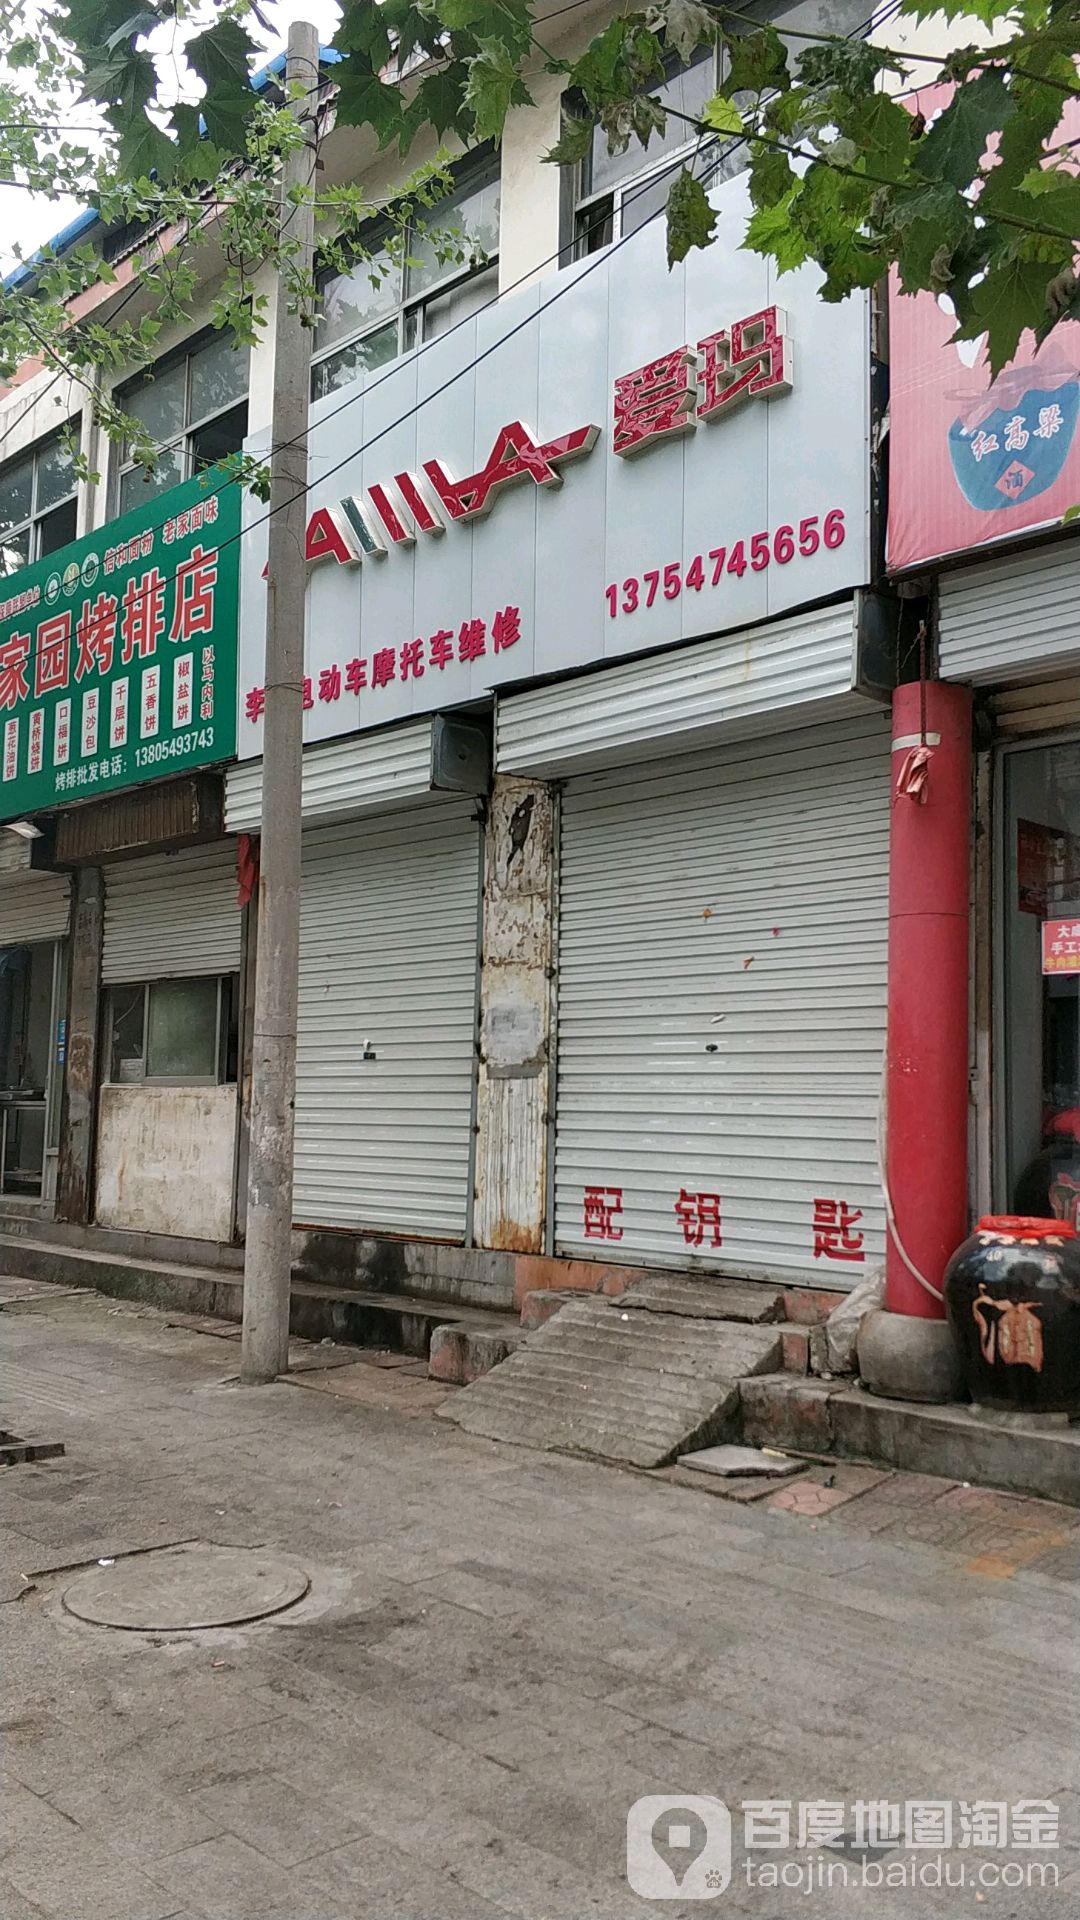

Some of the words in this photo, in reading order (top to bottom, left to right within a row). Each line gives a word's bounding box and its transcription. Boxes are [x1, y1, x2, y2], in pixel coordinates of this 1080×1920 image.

[613, 304, 793, 458] 爱玛
[971, 404, 1064, 462] 红高粱
[1005, 470, 1023, 489] 酒
[162, 496, 219, 545] 老家面味
[605, 508, 847, 619] 13754745656
[0, 544, 219, 712] 家园烤排店
[144, 673, 157, 731] 五香饼
[177, 661, 190, 720] 椒盐饼
[200, 645, 215, 720] 以马内利
[57, 706, 68, 758] 口福饼
[85, 695, 96, 749] 豆沙包
[114, 685, 126, 741] 千层饼
[135, 727, 214, 767] 13805493743
[583, 1185, 866, 1262] 配钥匙
